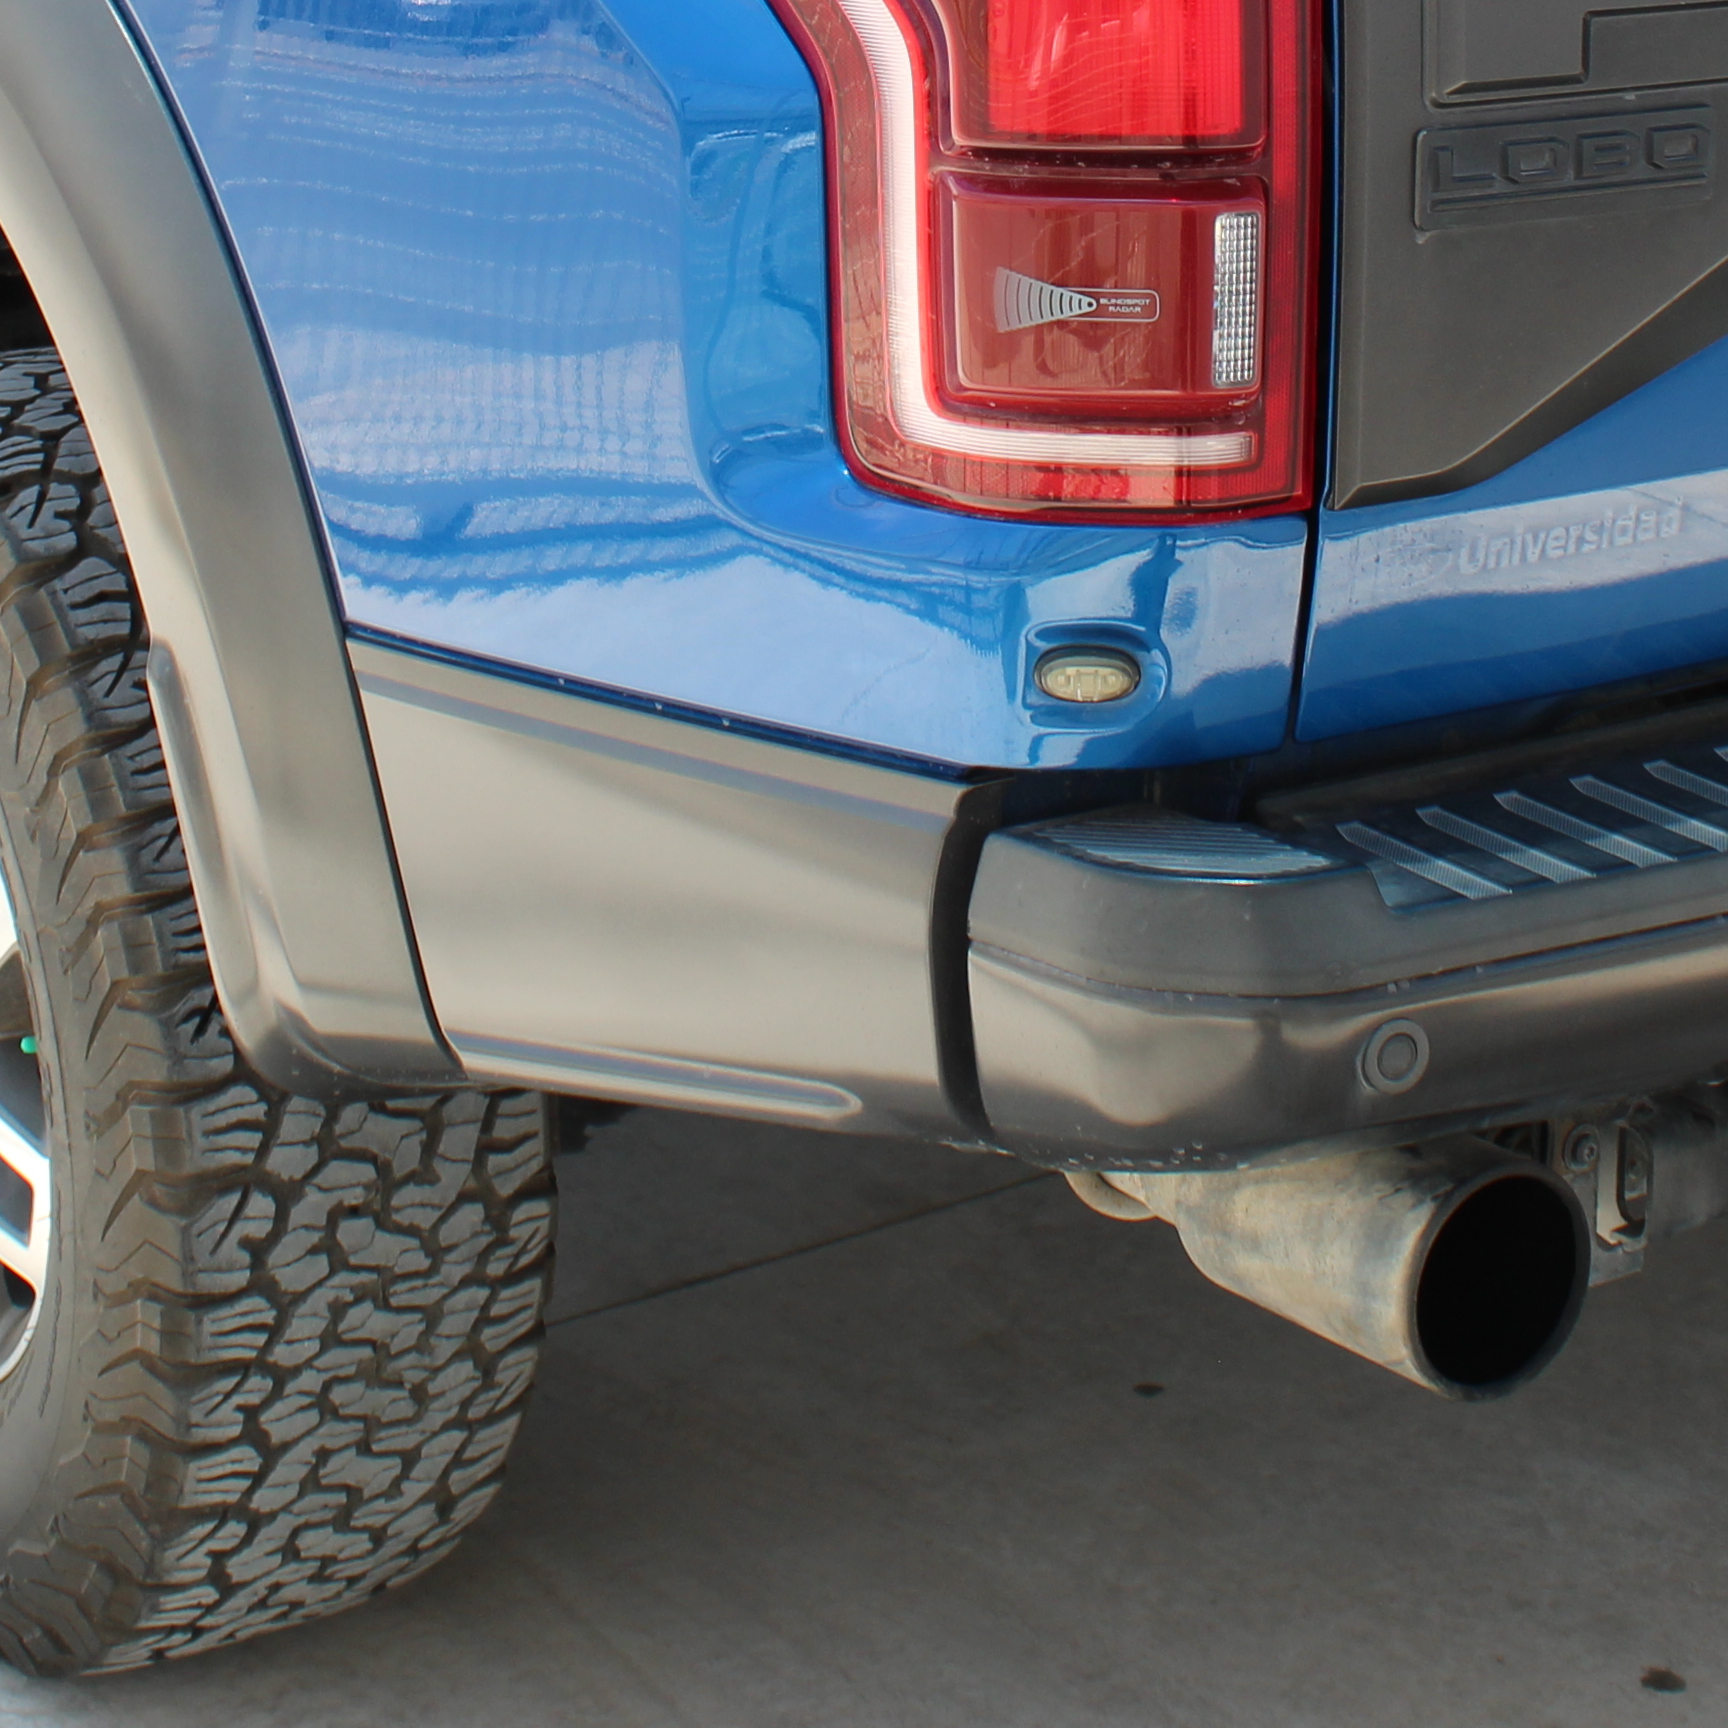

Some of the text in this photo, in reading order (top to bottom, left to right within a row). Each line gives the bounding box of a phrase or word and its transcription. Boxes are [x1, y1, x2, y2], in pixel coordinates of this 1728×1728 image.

[1427, 122, 1712, 193] LOBO
[1100, 298, 1152, 306] BLINDSPOT
[1458, 495, 1685, 575] Universidad
